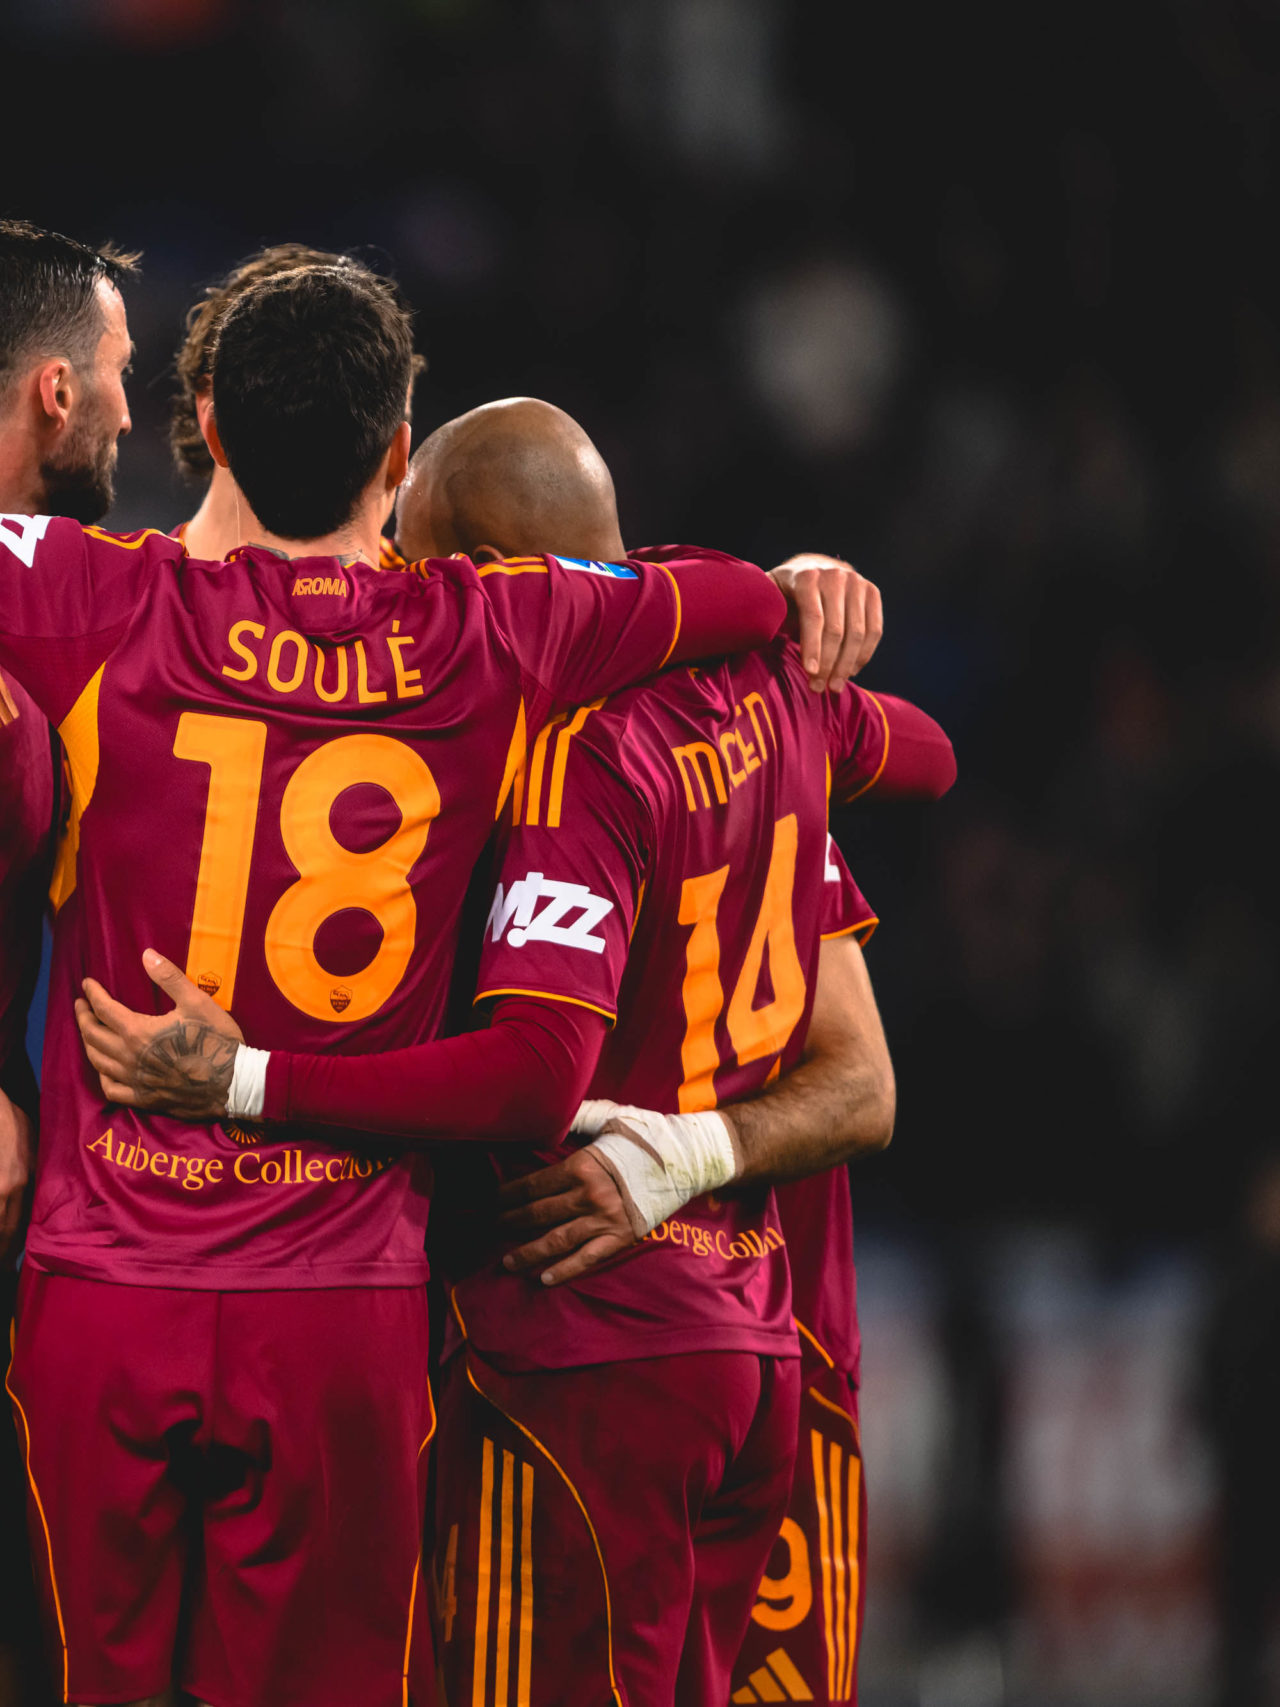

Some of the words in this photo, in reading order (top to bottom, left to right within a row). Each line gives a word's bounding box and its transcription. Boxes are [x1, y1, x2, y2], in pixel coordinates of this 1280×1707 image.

[222, 619, 424, 704] SOULÉ
[172, 711, 441, 1023] 18
[677, 813, 807, 1114] 14
[86, 1127, 223, 1191] Auberge
